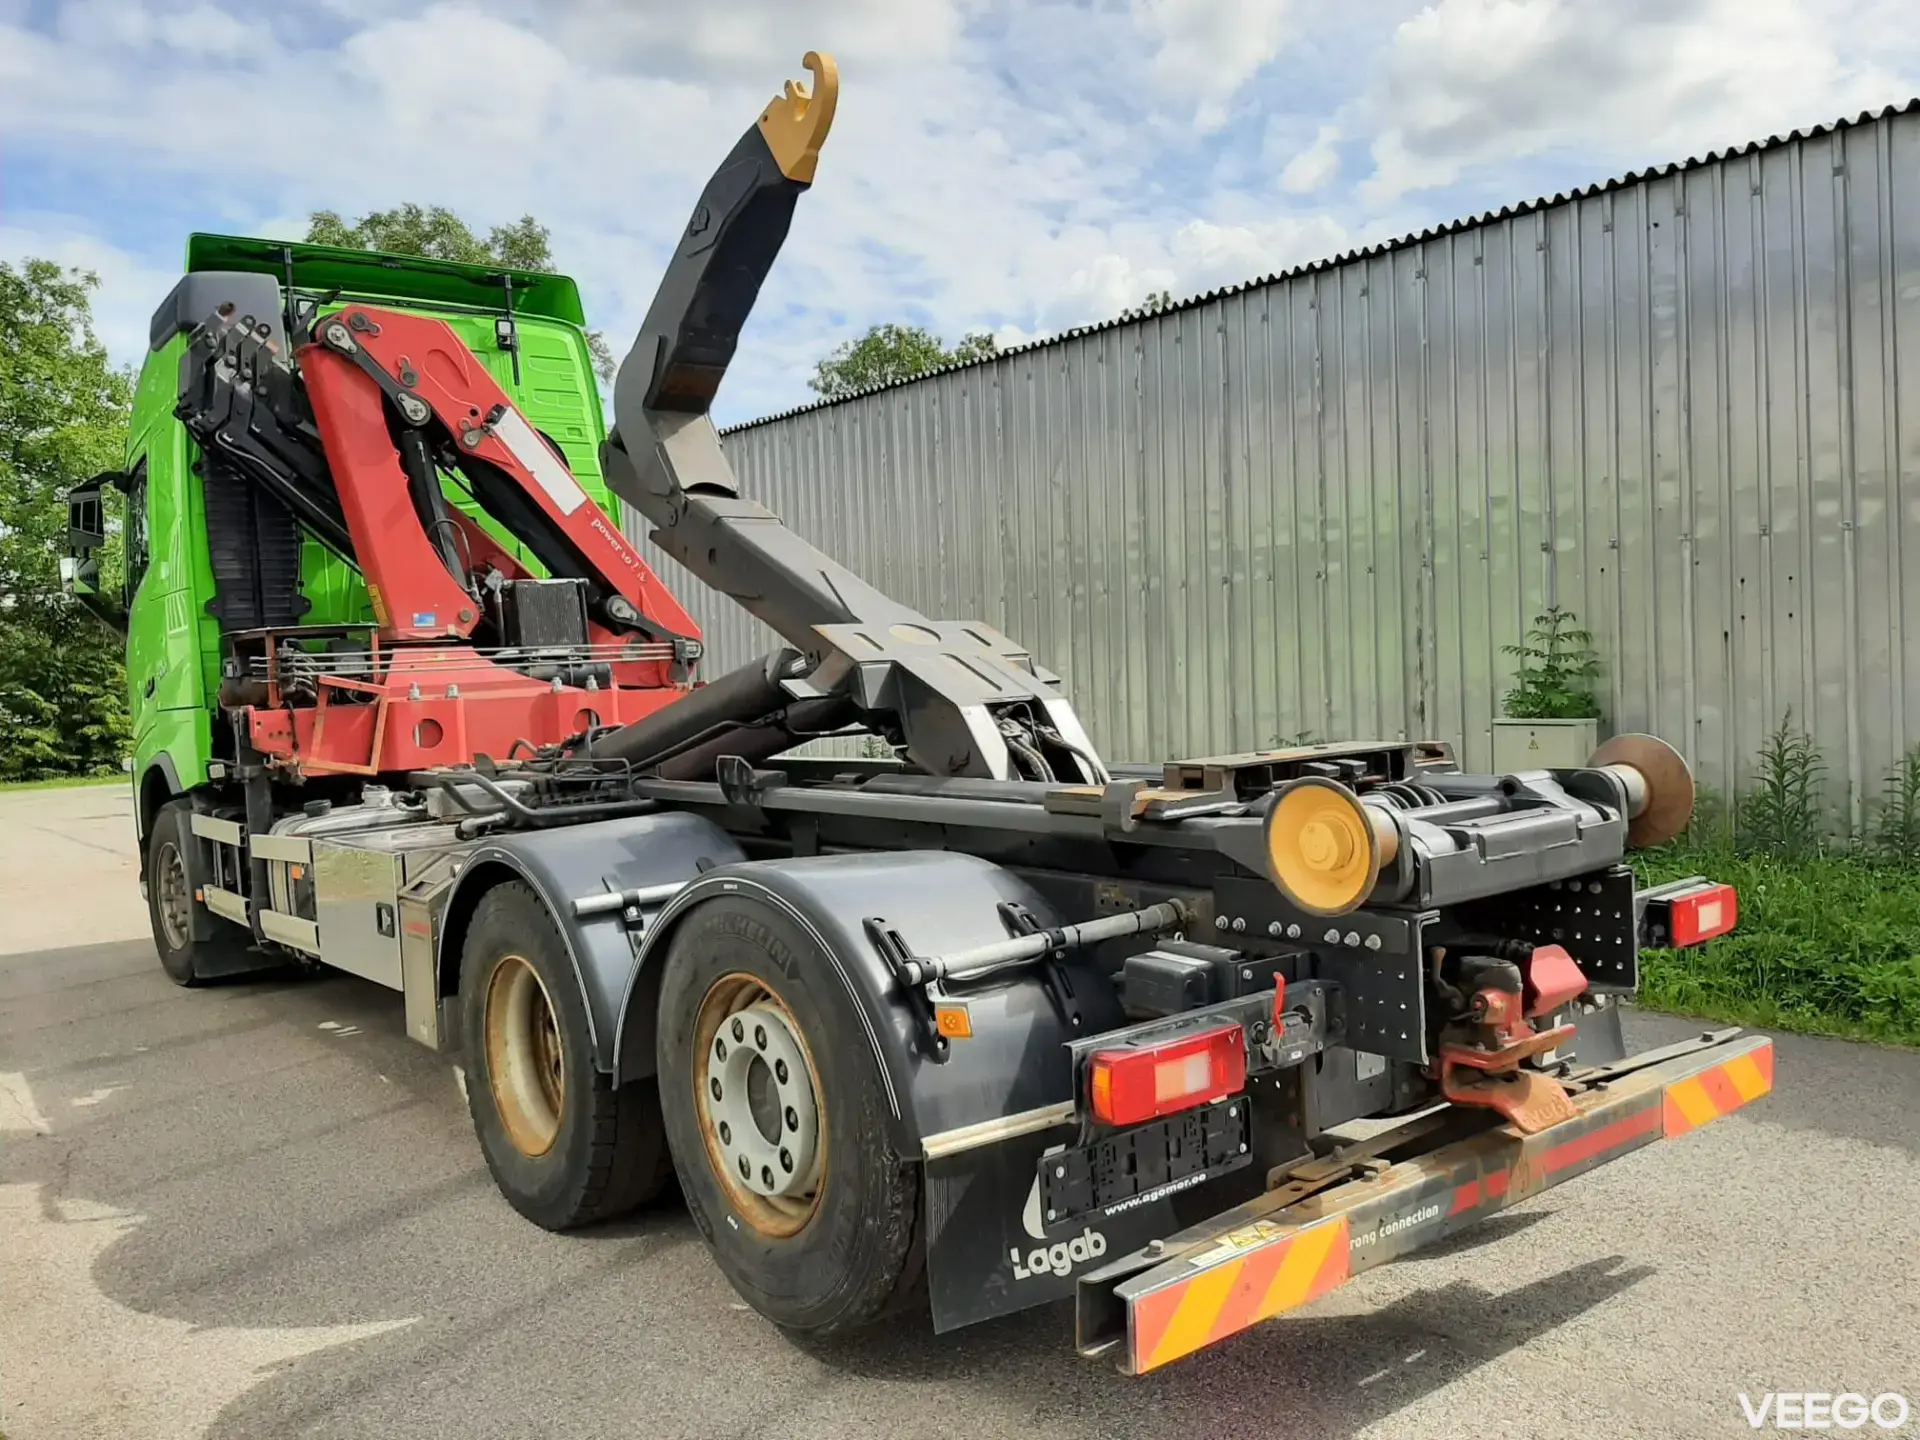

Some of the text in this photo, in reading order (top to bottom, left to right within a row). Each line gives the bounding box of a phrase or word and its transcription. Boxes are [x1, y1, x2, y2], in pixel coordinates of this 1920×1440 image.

[591, 518, 622, 551] power
[1379, 1204, 1439, 1238] connection
[1010, 1227, 1107, 1280] Lagab
